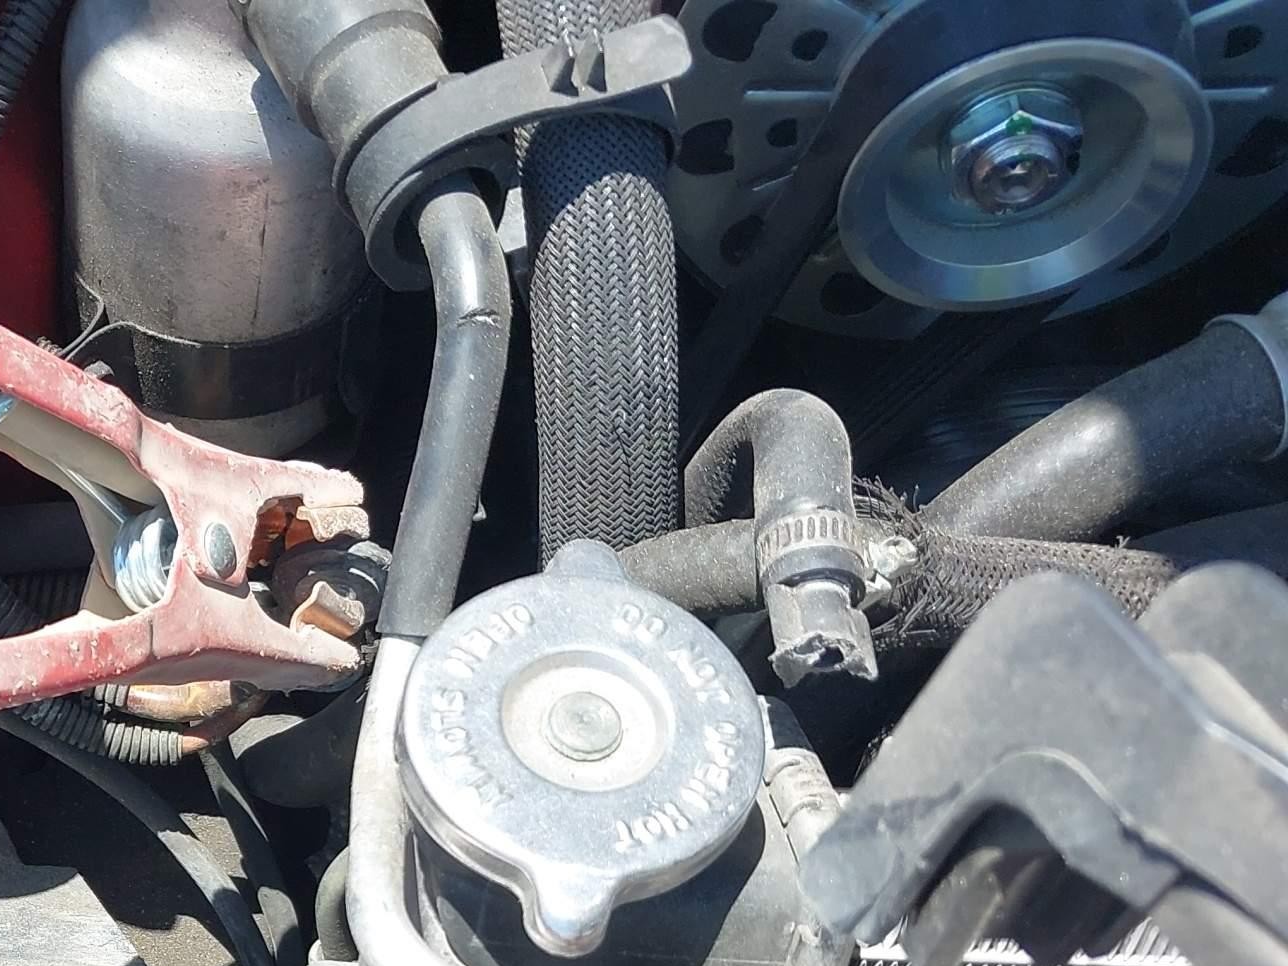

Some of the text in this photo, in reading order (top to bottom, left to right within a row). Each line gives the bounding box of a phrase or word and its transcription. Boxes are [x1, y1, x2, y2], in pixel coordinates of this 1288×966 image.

[443, 603, 535, 679] OPEN
[612, 603, 738, 853] DO NOT OPEN HOT
